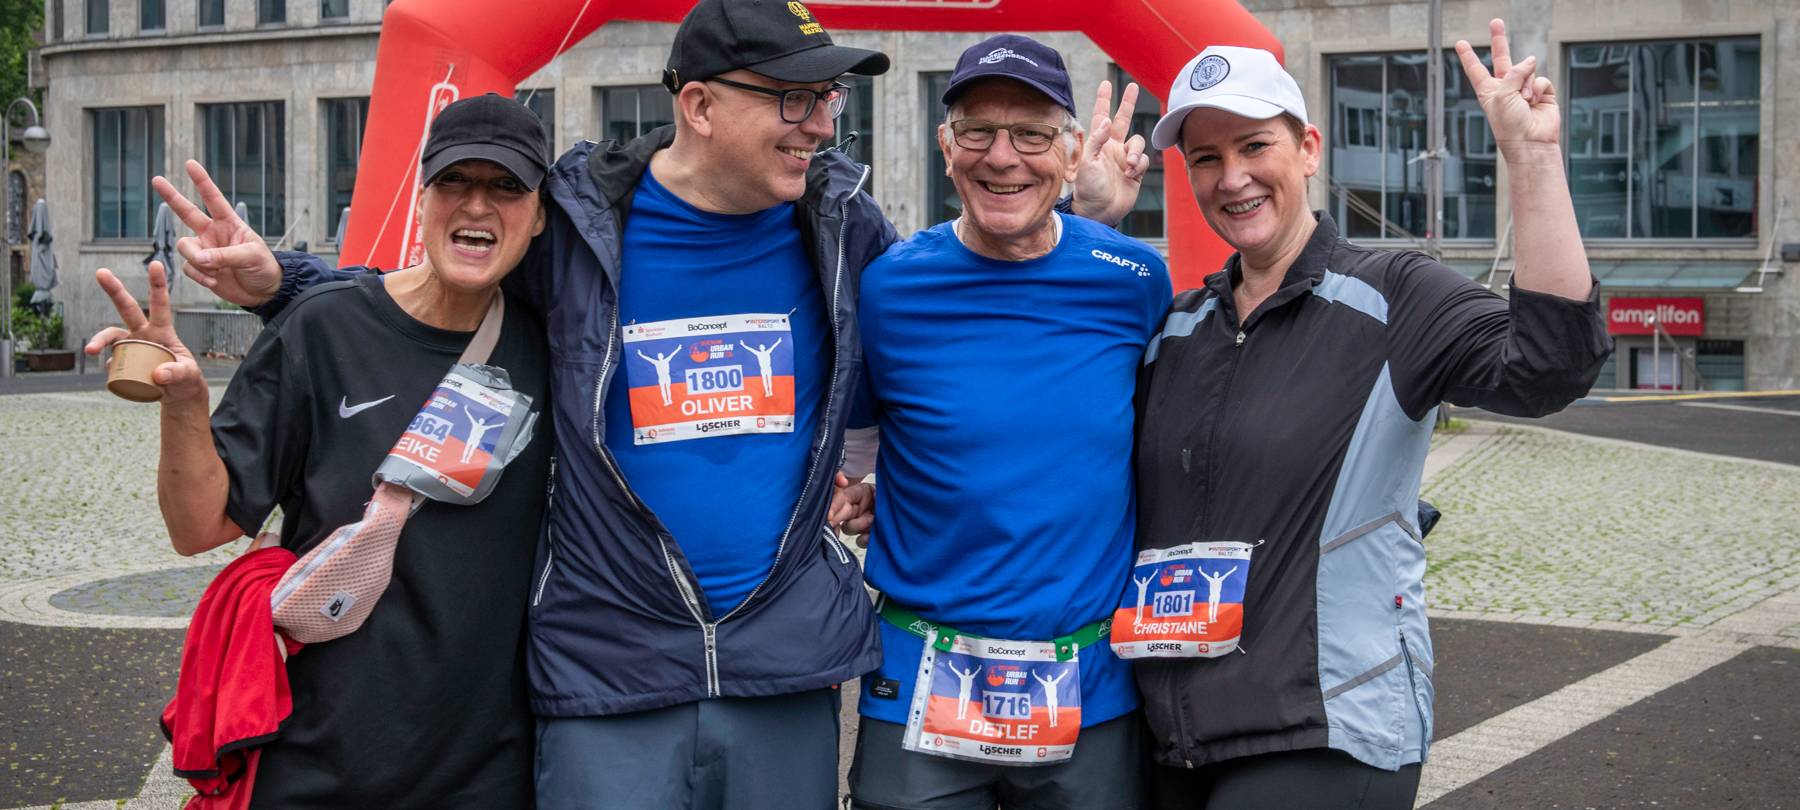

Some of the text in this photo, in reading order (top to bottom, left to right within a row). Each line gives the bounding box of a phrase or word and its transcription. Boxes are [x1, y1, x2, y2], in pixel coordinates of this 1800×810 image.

[1091, 249, 1140, 271] CRAFT
[1611, 305, 1699, 328] amplifon
[687, 321, 728, 332] BoConcept
[710, 344, 734, 352] URBAN
[710, 352, 725, 360] RUN
[687, 368, 743, 391] 1800
[681, 395, 754, 416] OLIVER
[409, 415, 450, 441] 964
[696, 419, 741, 433] LÖSCHER
[395, 436, 441, 463] EIKE
[1155, 593, 1191, 614] 1801
[1134, 621, 1208, 635] CHRISTIANE
[988, 646, 1026, 657] BoConcept
[1147, 643, 1182, 653] LÖSCHER
[1006, 671, 1028, 679] URBAN
[984, 695, 1030, 717] 1716
[969, 719, 1039, 740] DETLEF
[979, 744, 1022, 756] LÖSCHER
